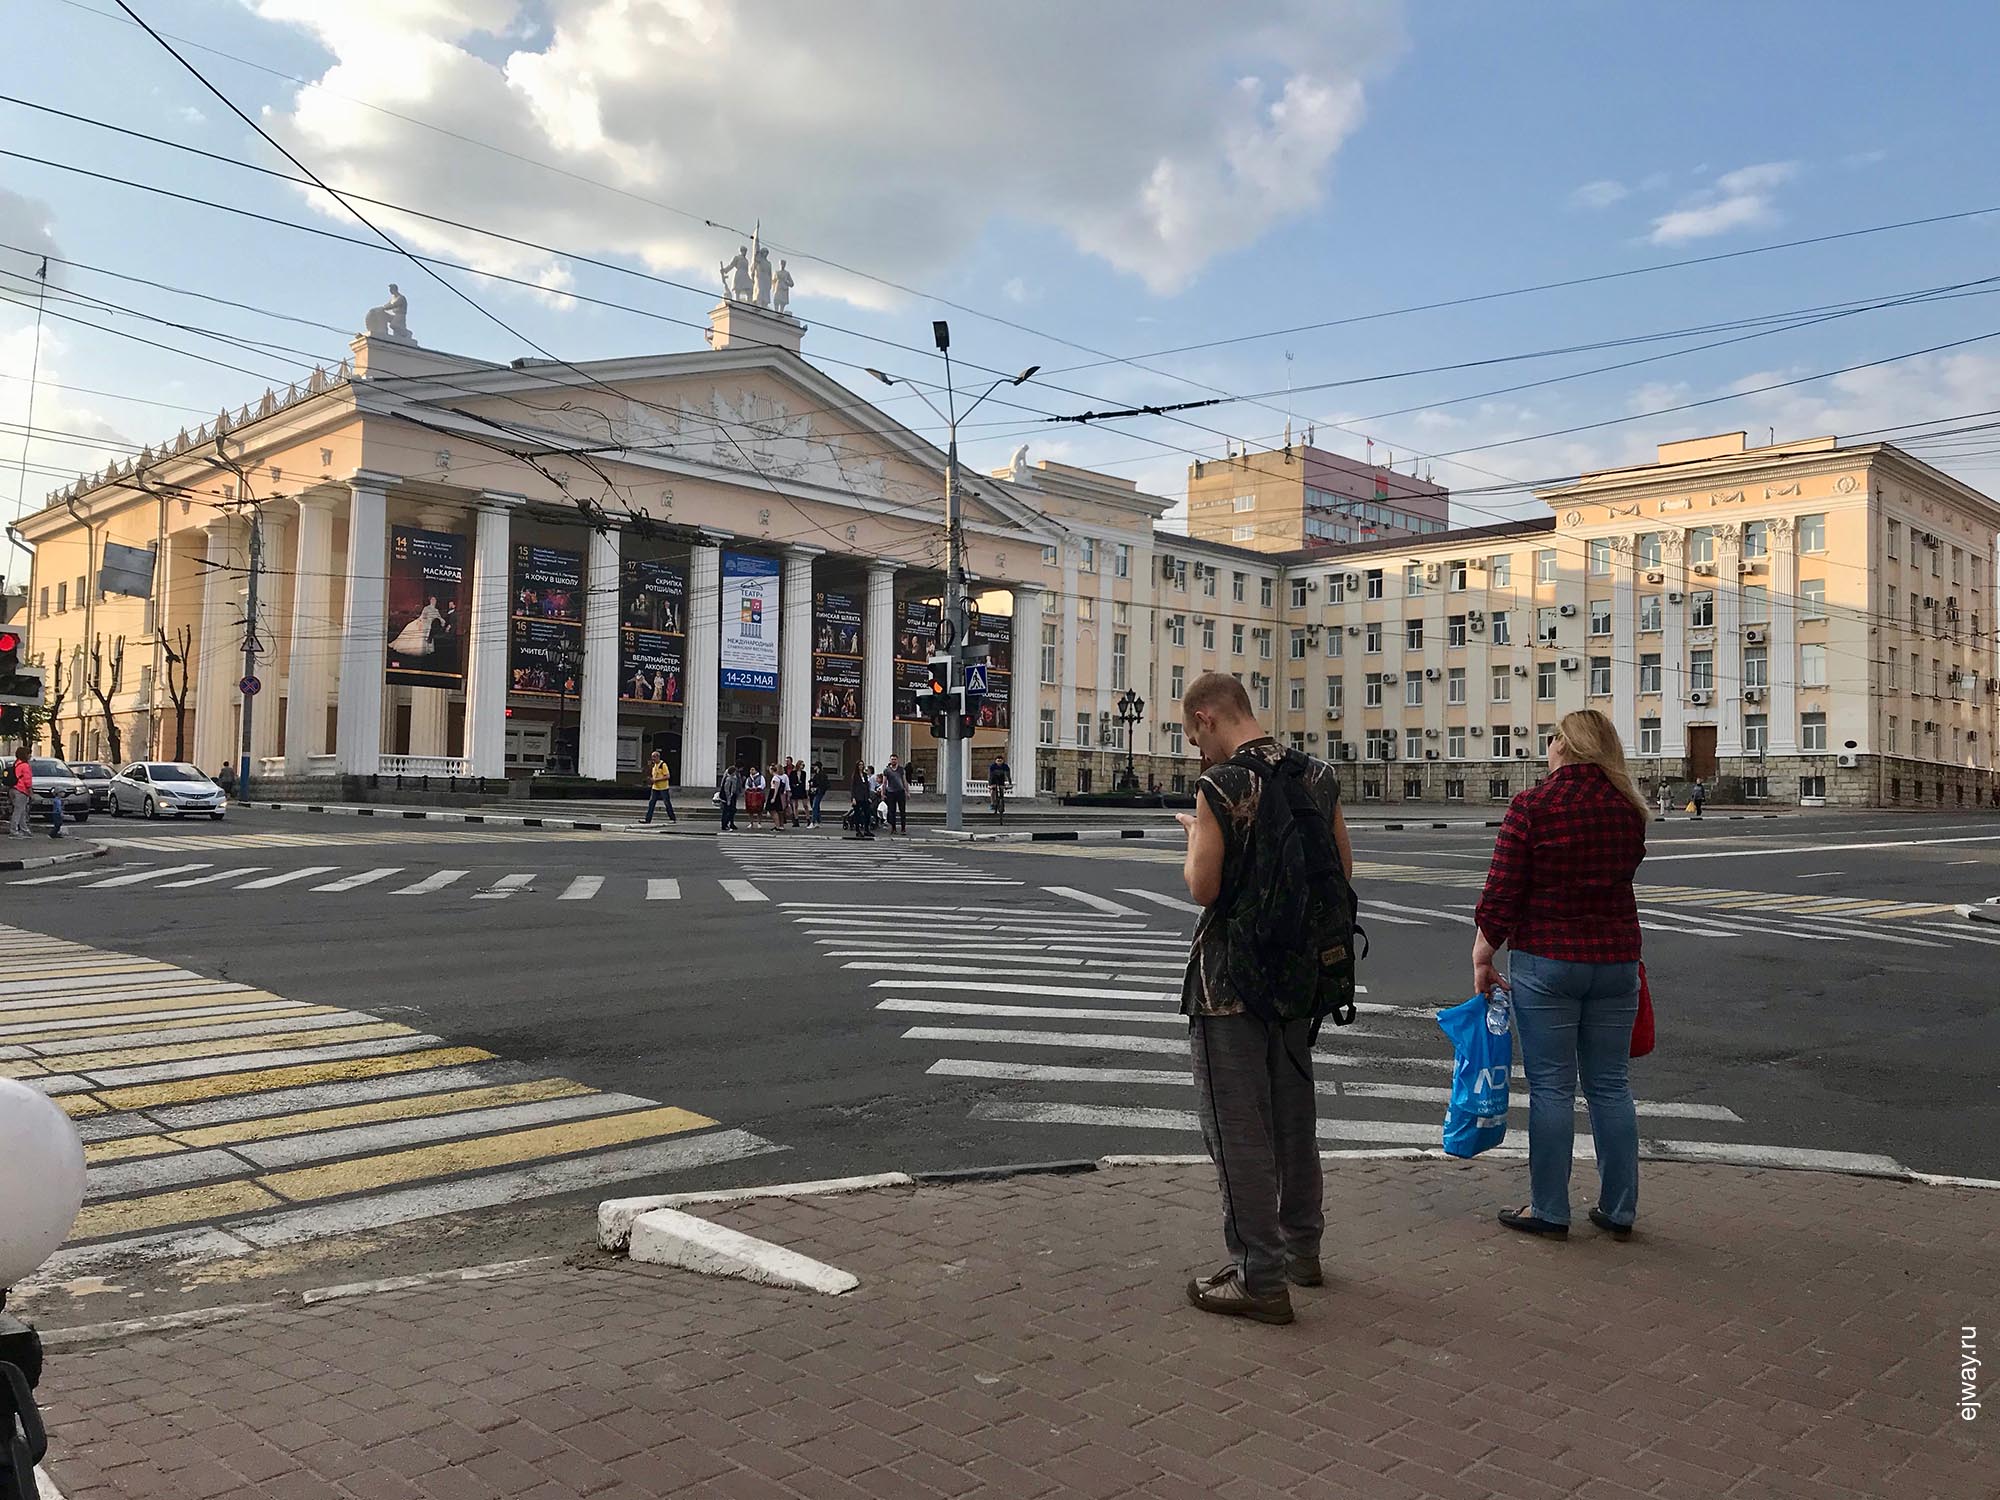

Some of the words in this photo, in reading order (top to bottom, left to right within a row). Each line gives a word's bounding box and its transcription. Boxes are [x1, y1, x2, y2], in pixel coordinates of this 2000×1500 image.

[395, 536, 407, 547] 14
[518, 545, 529, 556] 15
[423, 567, 462, 580] МАСКАРАД
[530, 574, 549, 582] ХОЧУ
[555, 577, 579, 586] ШКОЛУ
[655, 578, 683, 588] СКРИПКА
[645, 584, 683, 595] РОТШИЛЬДА
[816, 592, 825, 602] 19
[516, 621, 527, 631] 16
[624, 632, 635, 642] 18
[1000, 633, 1010, 641] САД
[520, 647, 548, 656] УЧИТЕЛ
[632, 654, 681, 665] ВЕЛЬТМАЙСТЕР-
[815, 657, 826, 666] 20
[644, 664, 681, 673] АККОРДЕОН
[896, 663, 905, 671] 22
[726, 672, 752, 685] 14-25
[753, 675, 774, 686] МАЯ
